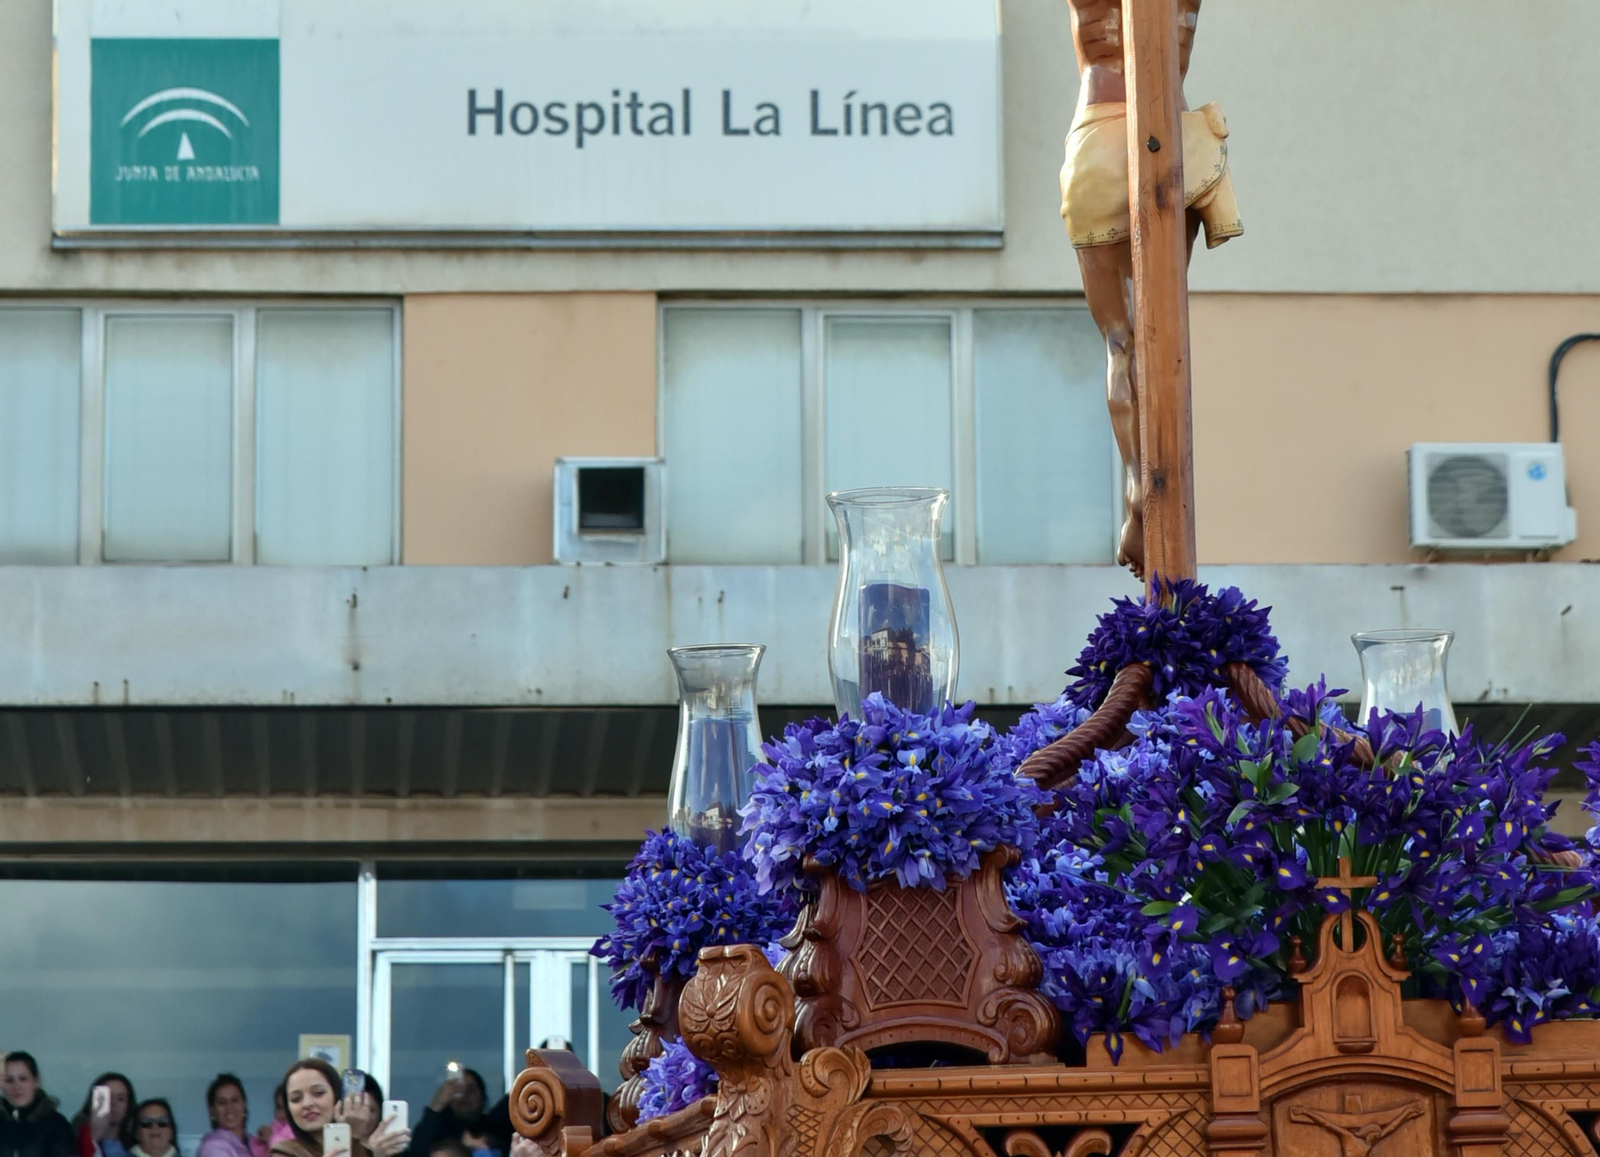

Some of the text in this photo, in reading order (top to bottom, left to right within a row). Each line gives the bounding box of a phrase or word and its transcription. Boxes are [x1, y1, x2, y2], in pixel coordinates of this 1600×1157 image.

[467, 88, 955, 149] Hospital La Línea
[115, 165, 159, 182] JUNTA
[164, 165, 181, 182] DE
